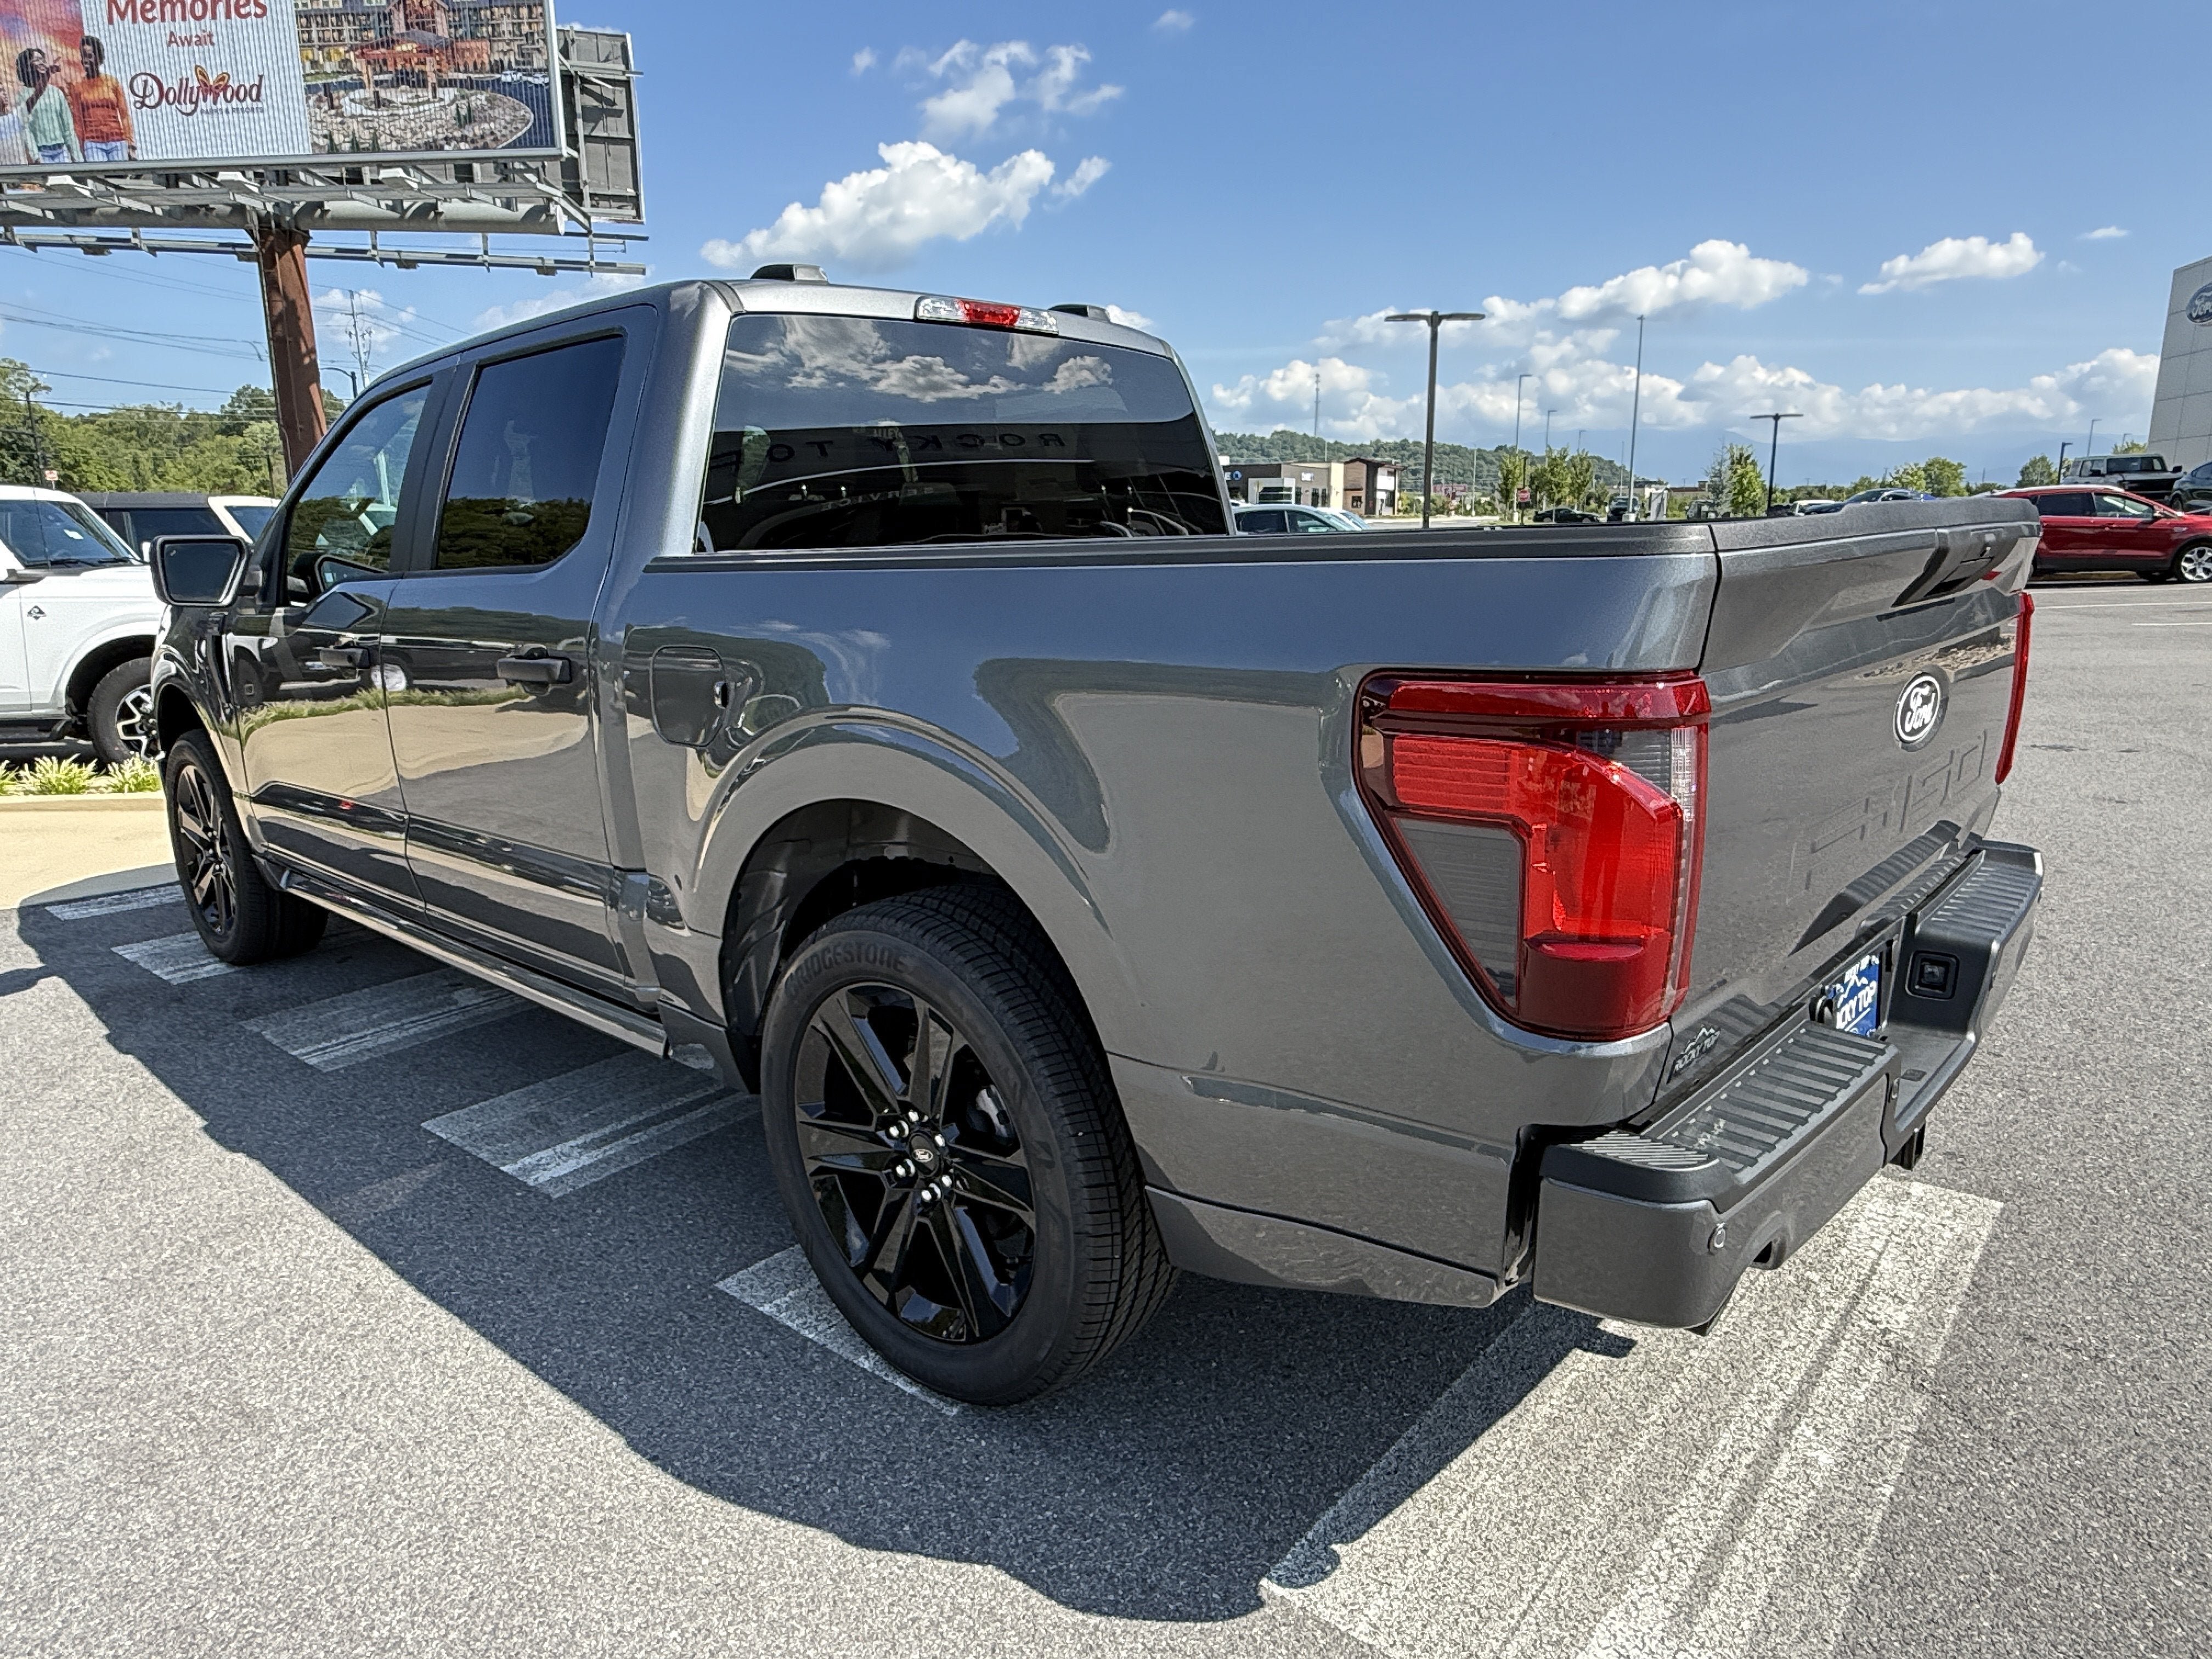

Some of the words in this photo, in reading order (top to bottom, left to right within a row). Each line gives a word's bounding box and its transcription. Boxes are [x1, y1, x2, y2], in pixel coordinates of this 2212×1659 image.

[108, 0, 268, 25] Memories
[167, 30, 215, 47] Await
[2192, 292, 2212, 318] For
[1904, 683, 1936, 733] Ford
